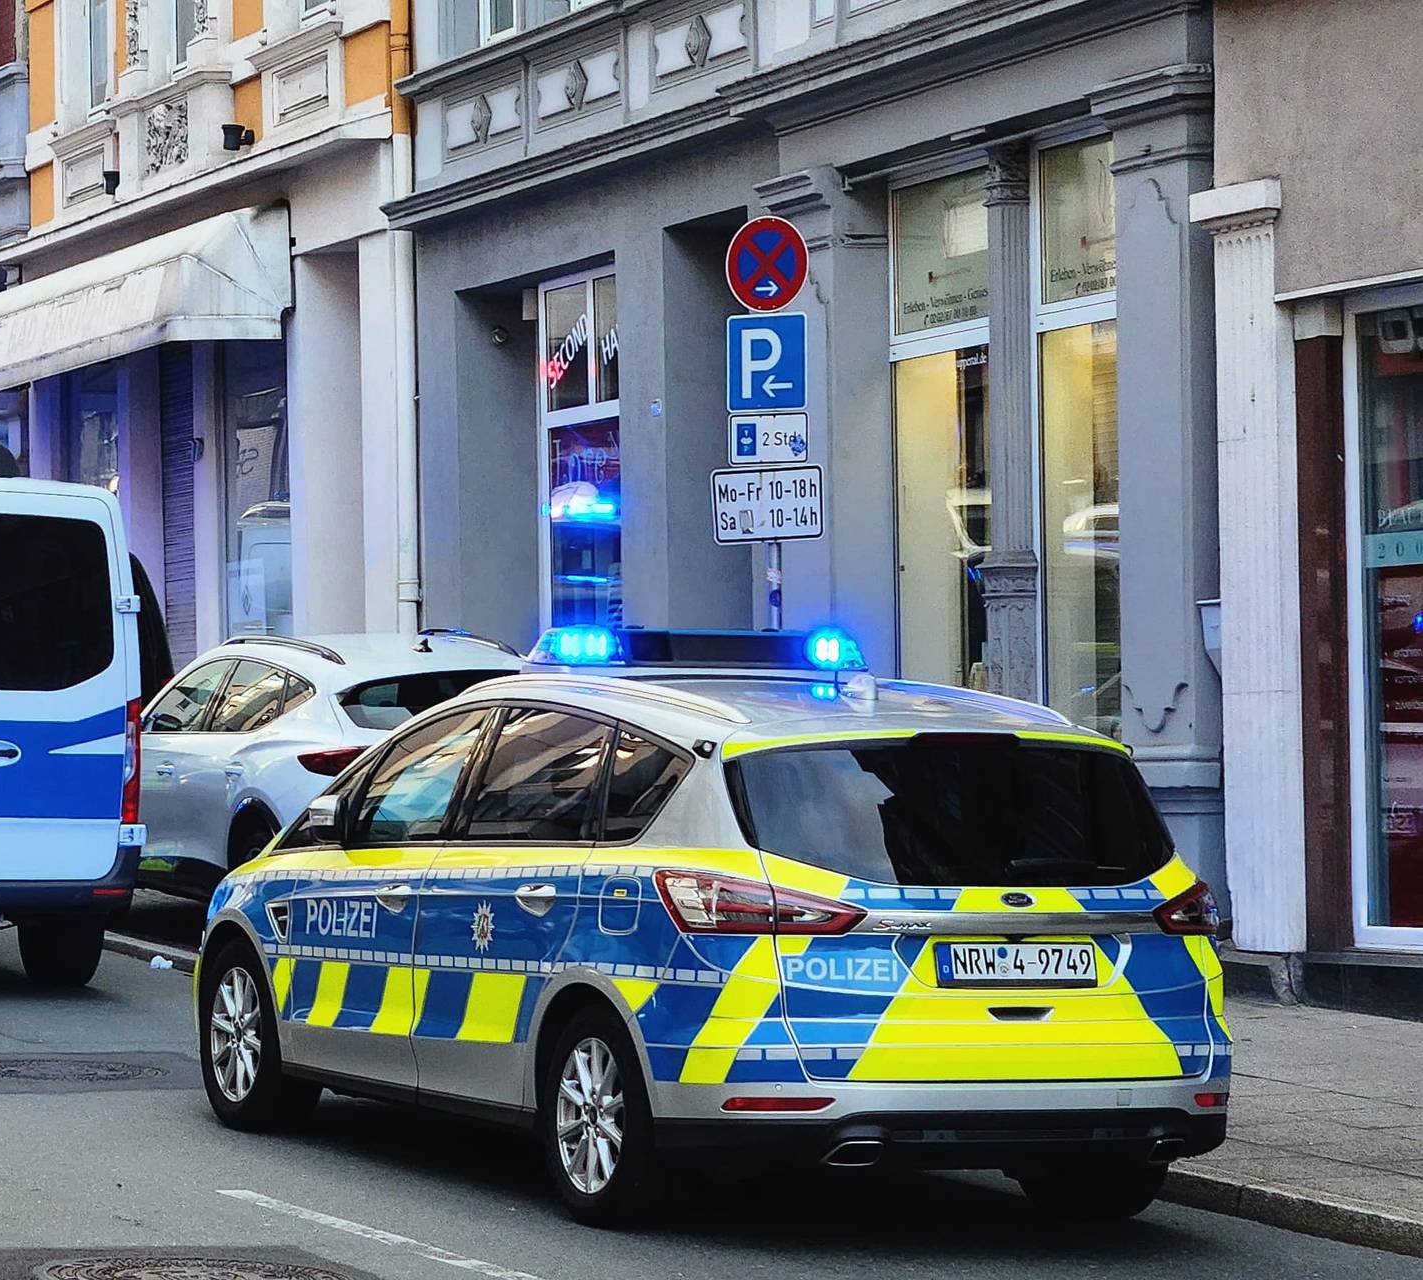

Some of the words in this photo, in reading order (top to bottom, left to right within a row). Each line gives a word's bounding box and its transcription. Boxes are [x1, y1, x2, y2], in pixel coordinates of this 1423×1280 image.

[547, 313, 589, 390] SECOND
[601, 322, 619, 365] HA
[741, 327, 782, 399] P
[762, 432, 770, 446] 2
[718, 482, 762, 504] Mo-Fr
[306, 899, 377, 939] POLIZEI
[786, 957, 898, 982] POLIZEI
[954, 948, 997, 976] NRW
